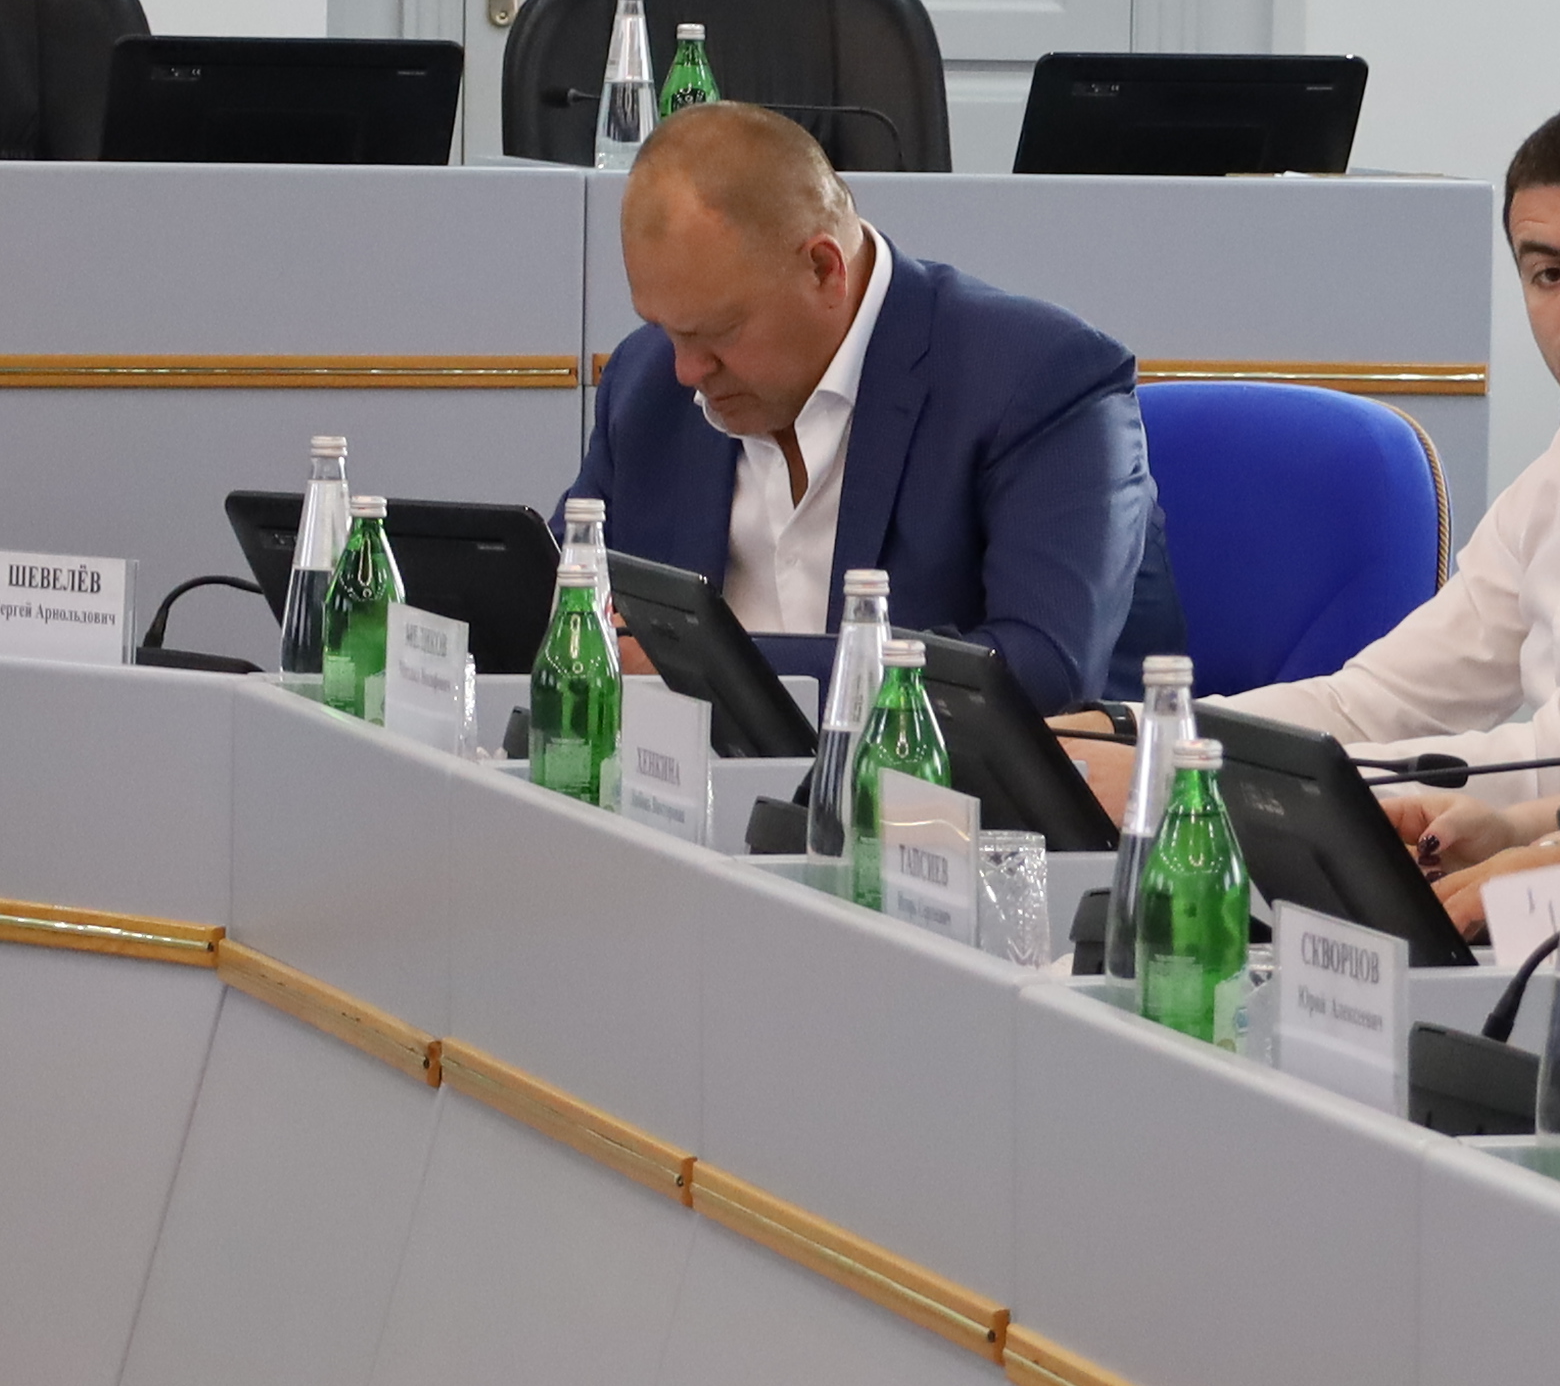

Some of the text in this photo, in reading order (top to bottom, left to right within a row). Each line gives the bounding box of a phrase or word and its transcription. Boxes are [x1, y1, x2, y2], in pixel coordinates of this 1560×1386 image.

[8, 564, 101, 594] ШЕВЕЛЁВ
[36, 603, 116, 626] Арнольдович
[1301, 931, 1380, 985] СКВОРЦОВ
